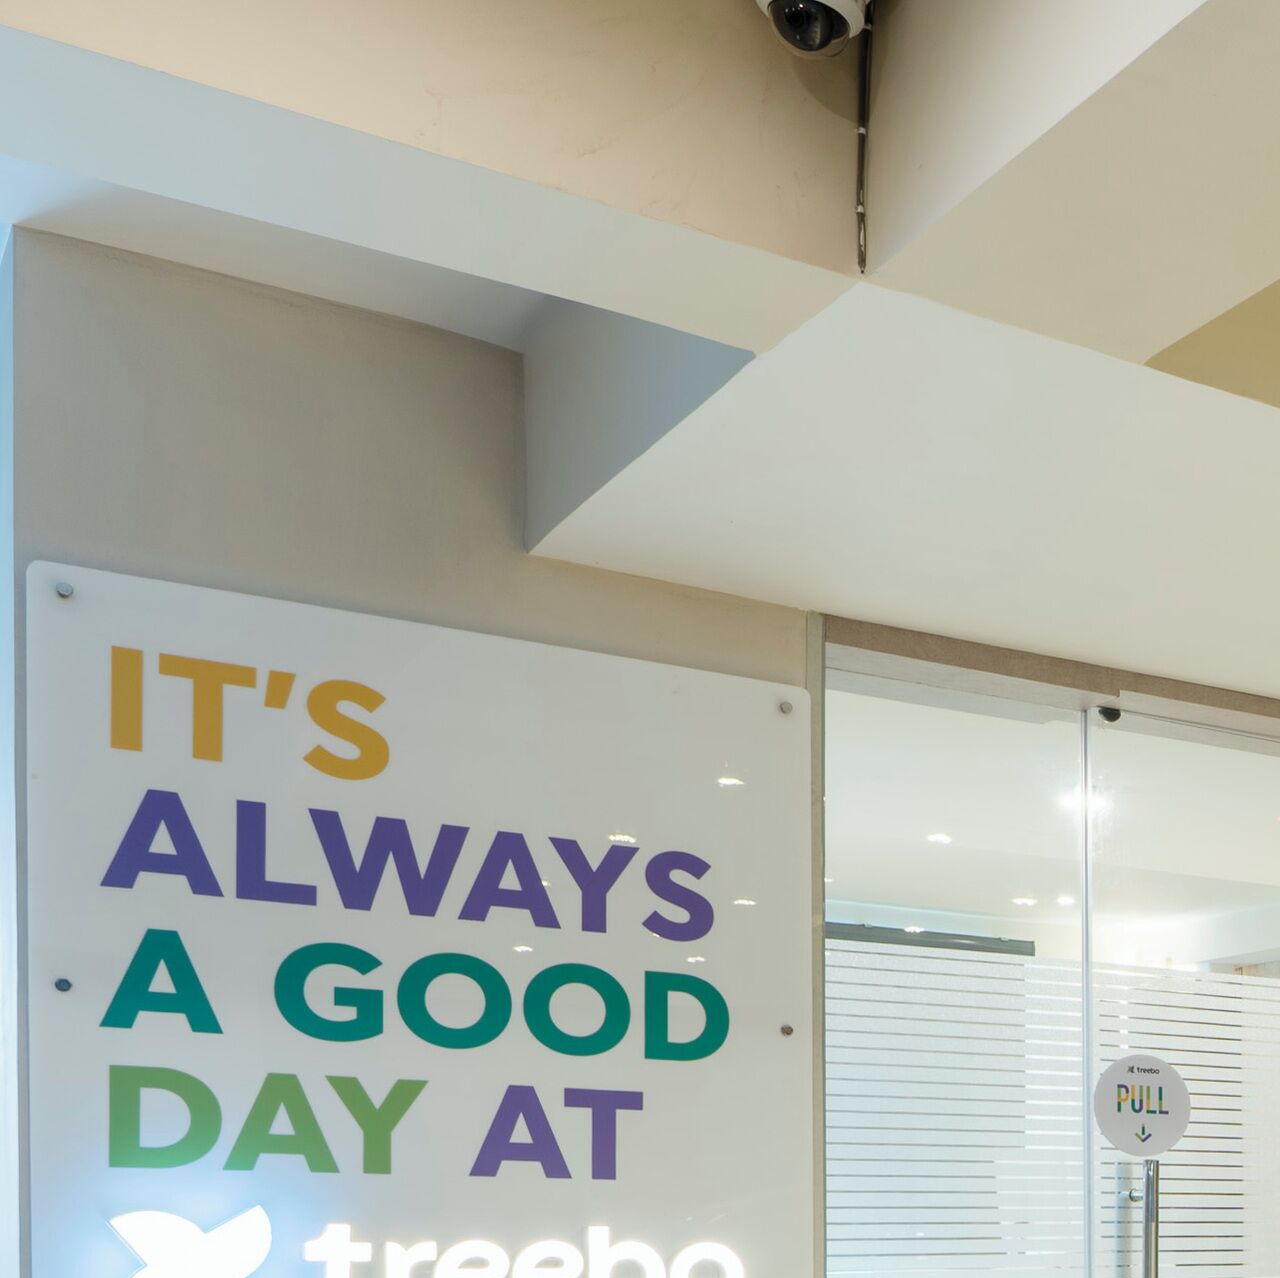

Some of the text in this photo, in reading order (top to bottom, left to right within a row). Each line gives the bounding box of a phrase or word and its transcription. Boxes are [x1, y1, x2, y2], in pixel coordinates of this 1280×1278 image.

[110, 646, 390, 781] IT'S
[100, 789, 715, 941] ALWAYS
[100, 929, 730, 1061] A GOOD
[108, 1065, 643, 1180] DAY AT
[1117, 1084, 1169, 1115] PULL
[1136, 1066, 1160, 1075] treebo
